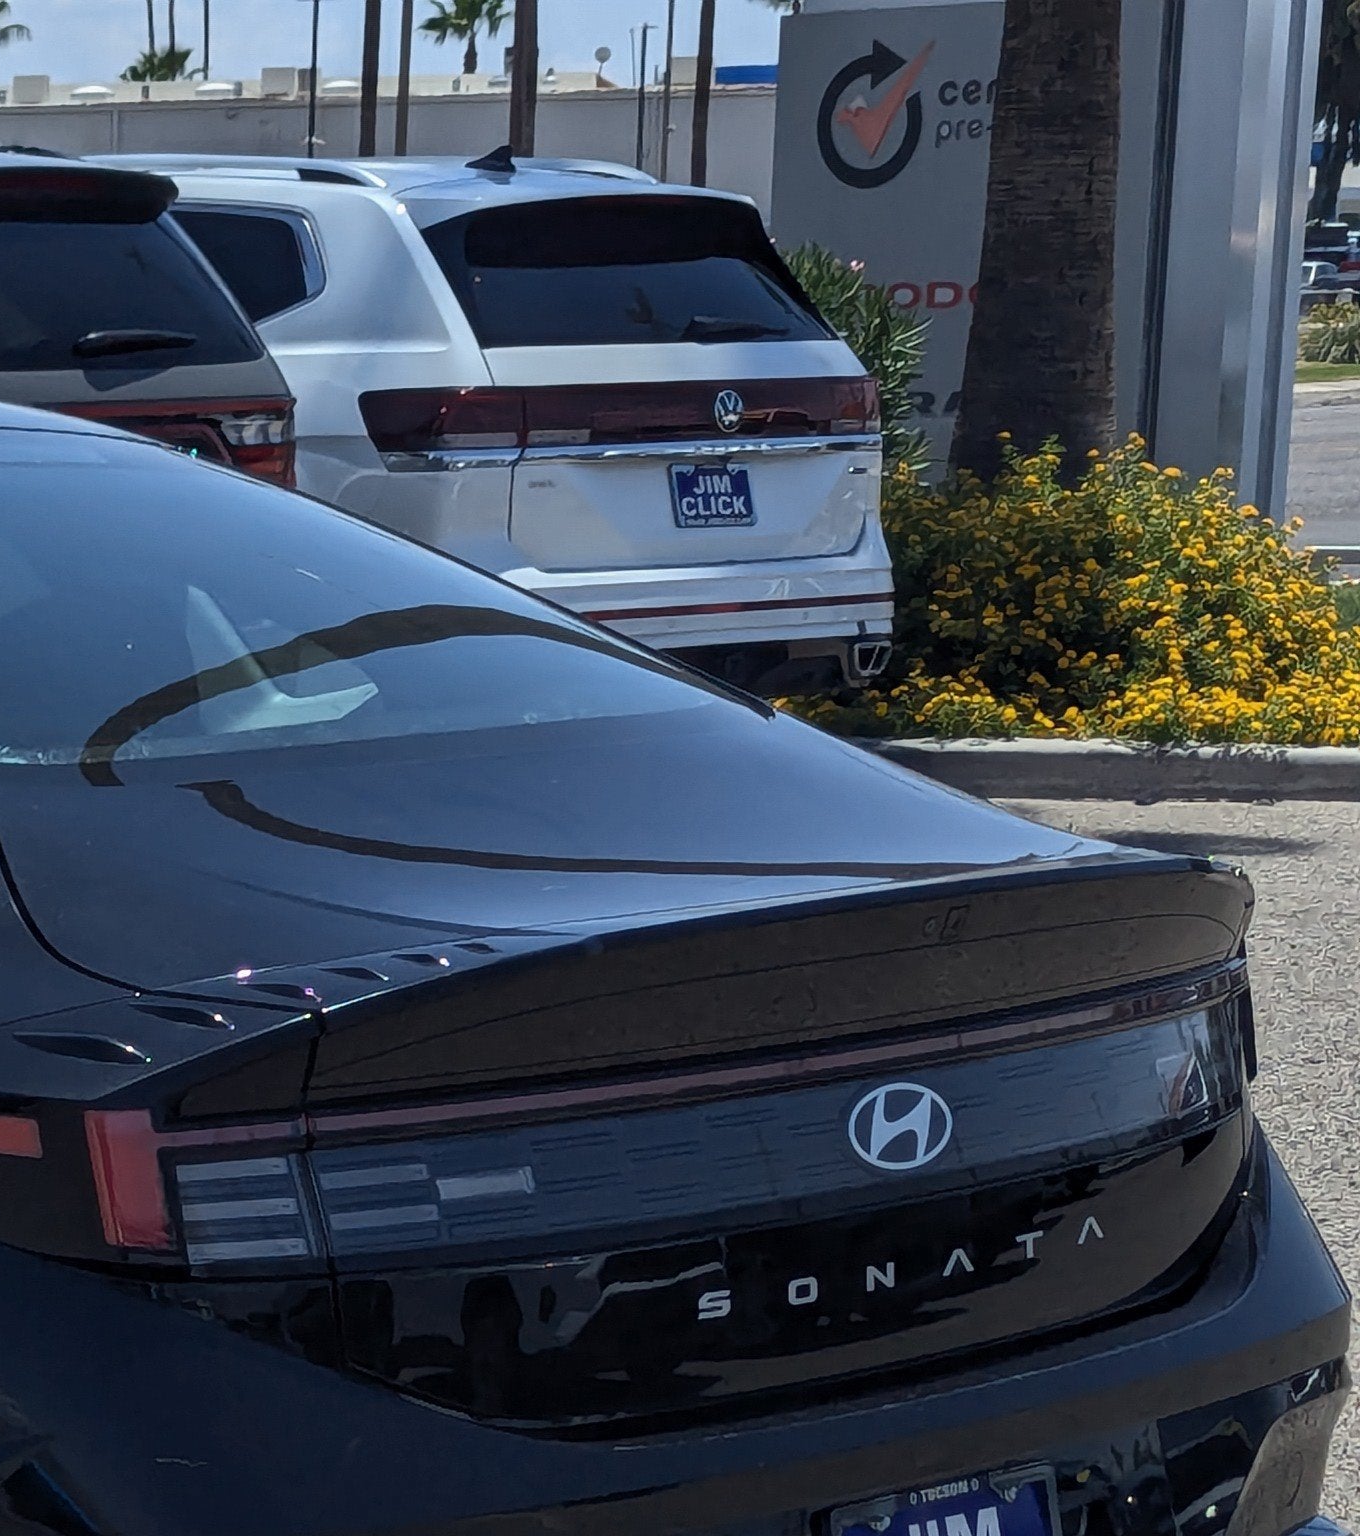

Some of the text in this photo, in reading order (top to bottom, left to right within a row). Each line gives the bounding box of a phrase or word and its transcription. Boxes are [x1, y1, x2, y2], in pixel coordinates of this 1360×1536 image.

[693, 475, 732, 494] JIM
[682, 496, 747, 516] CLICK
[698, 1215, 1105, 1320] SONATA
